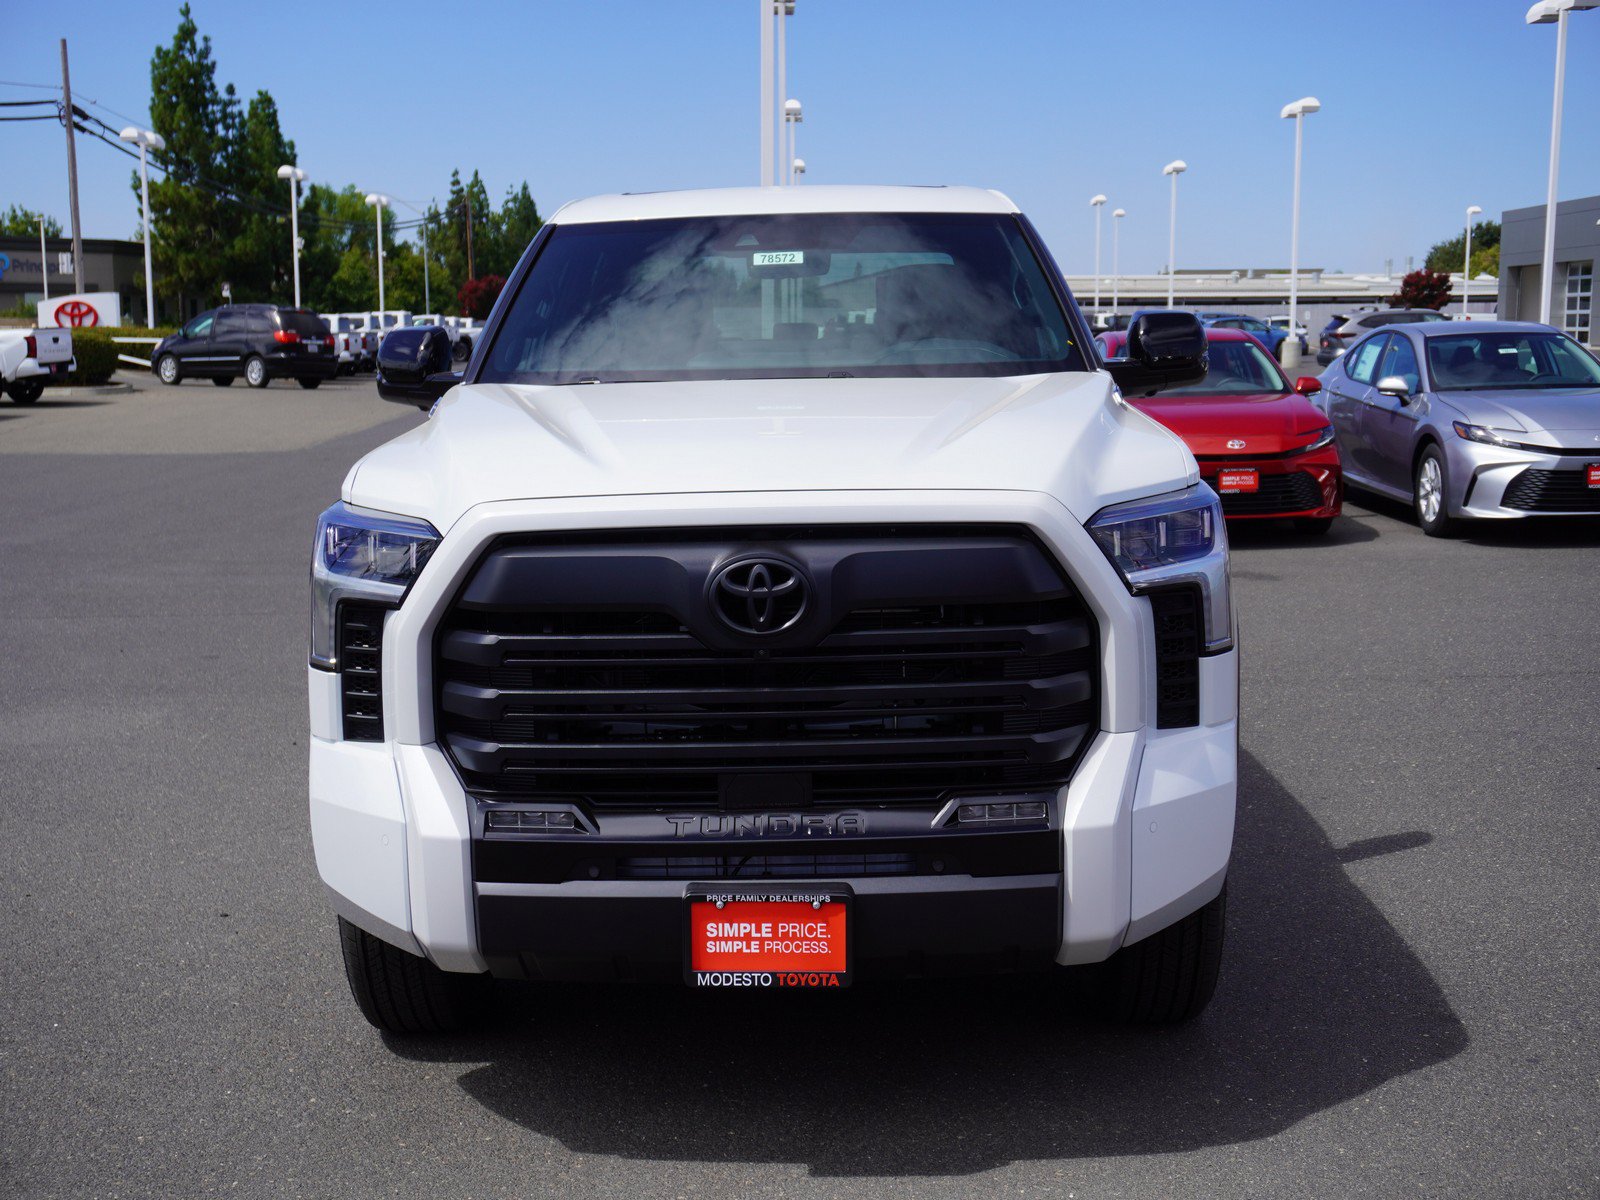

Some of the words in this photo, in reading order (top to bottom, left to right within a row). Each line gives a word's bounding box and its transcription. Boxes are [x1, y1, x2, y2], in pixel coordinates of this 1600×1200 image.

[761, 253, 796, 264] 78572
[665, 813, 867, 838] TUNDRA
[769, 895, 831, 903] DEALERSHIPS
[706, 923, 772, 938] SIMPLE
[778, 923, 831, 938] PRICE.
[706, 941, 760, 954] SIMPLE
[764, 941, 832, 954] PROCESS.
[697, 973, 772, 987] MODESTO
[777, 973, 840, 987] TOYOTA
